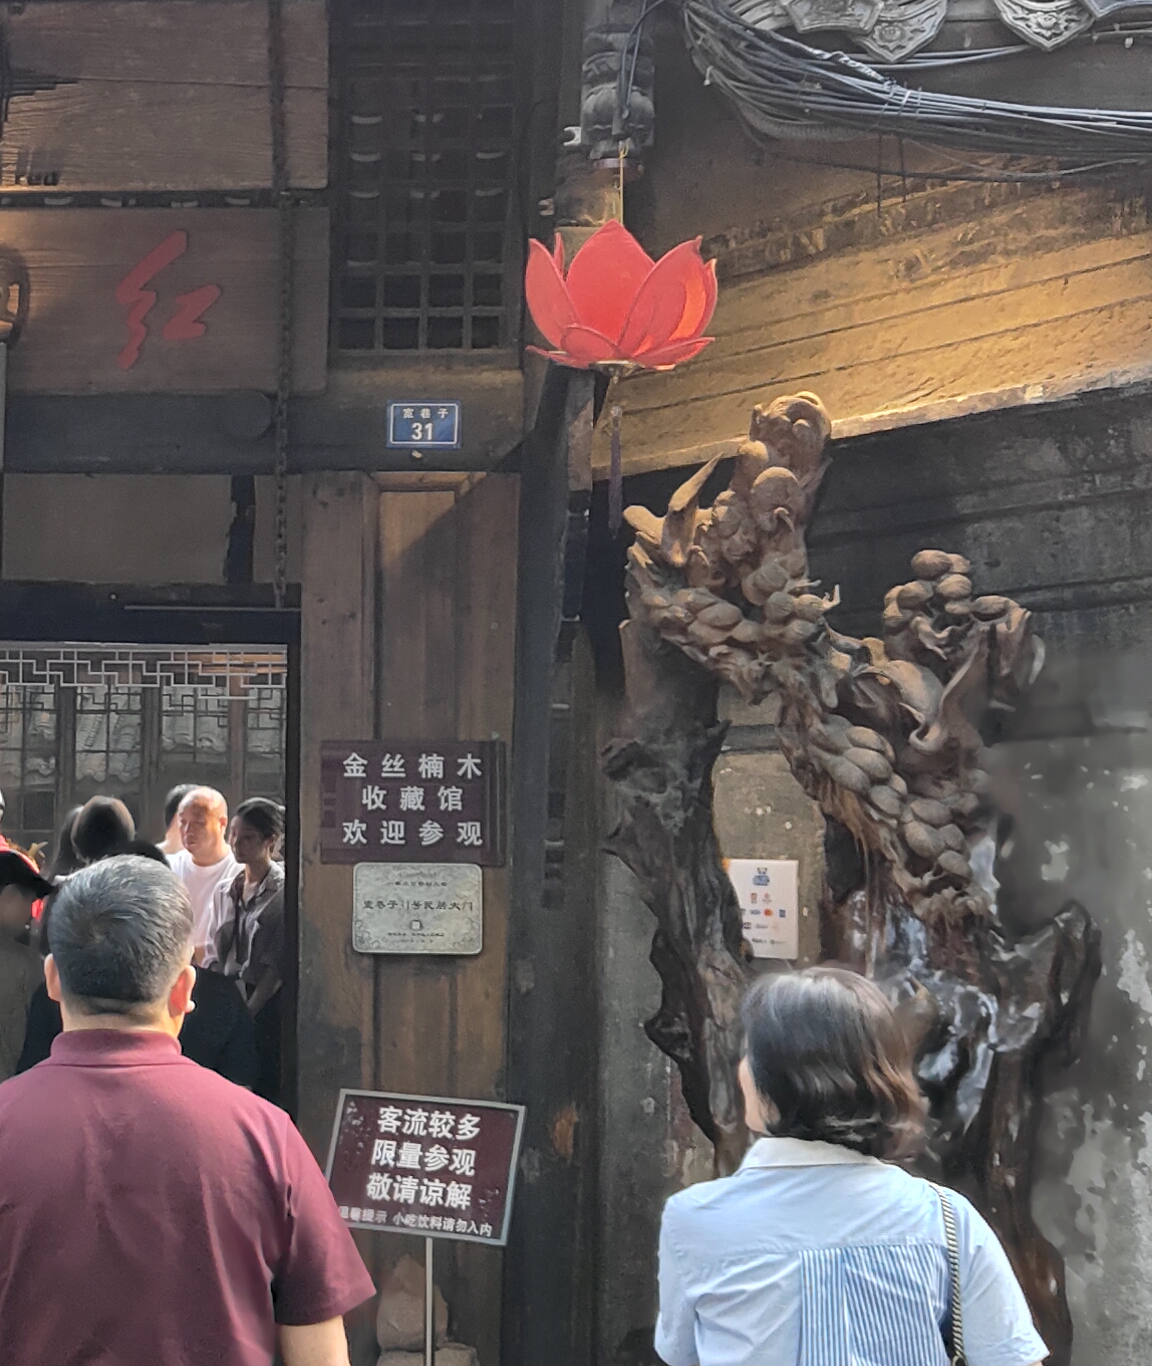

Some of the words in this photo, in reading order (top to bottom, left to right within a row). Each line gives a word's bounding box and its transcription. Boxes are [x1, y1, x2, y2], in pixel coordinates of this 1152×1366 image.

[403, 407, 449, 419] 宽巷子
[411, 422, 434, 441] 31
[342, 752, 483, 779] 金丝楠木
[361, 785, 463, 811] 收藏馆
[342, 819, 484, 846] 欢迎参观
[376, 1105, 481, 1141] 客流较多
[370, 1138, 477, 1177] 限量参观
[365, 1172, 473, 1211] 敬请谅解
[392, 1212, 494, 1238] 小吃饮料请勿入内
